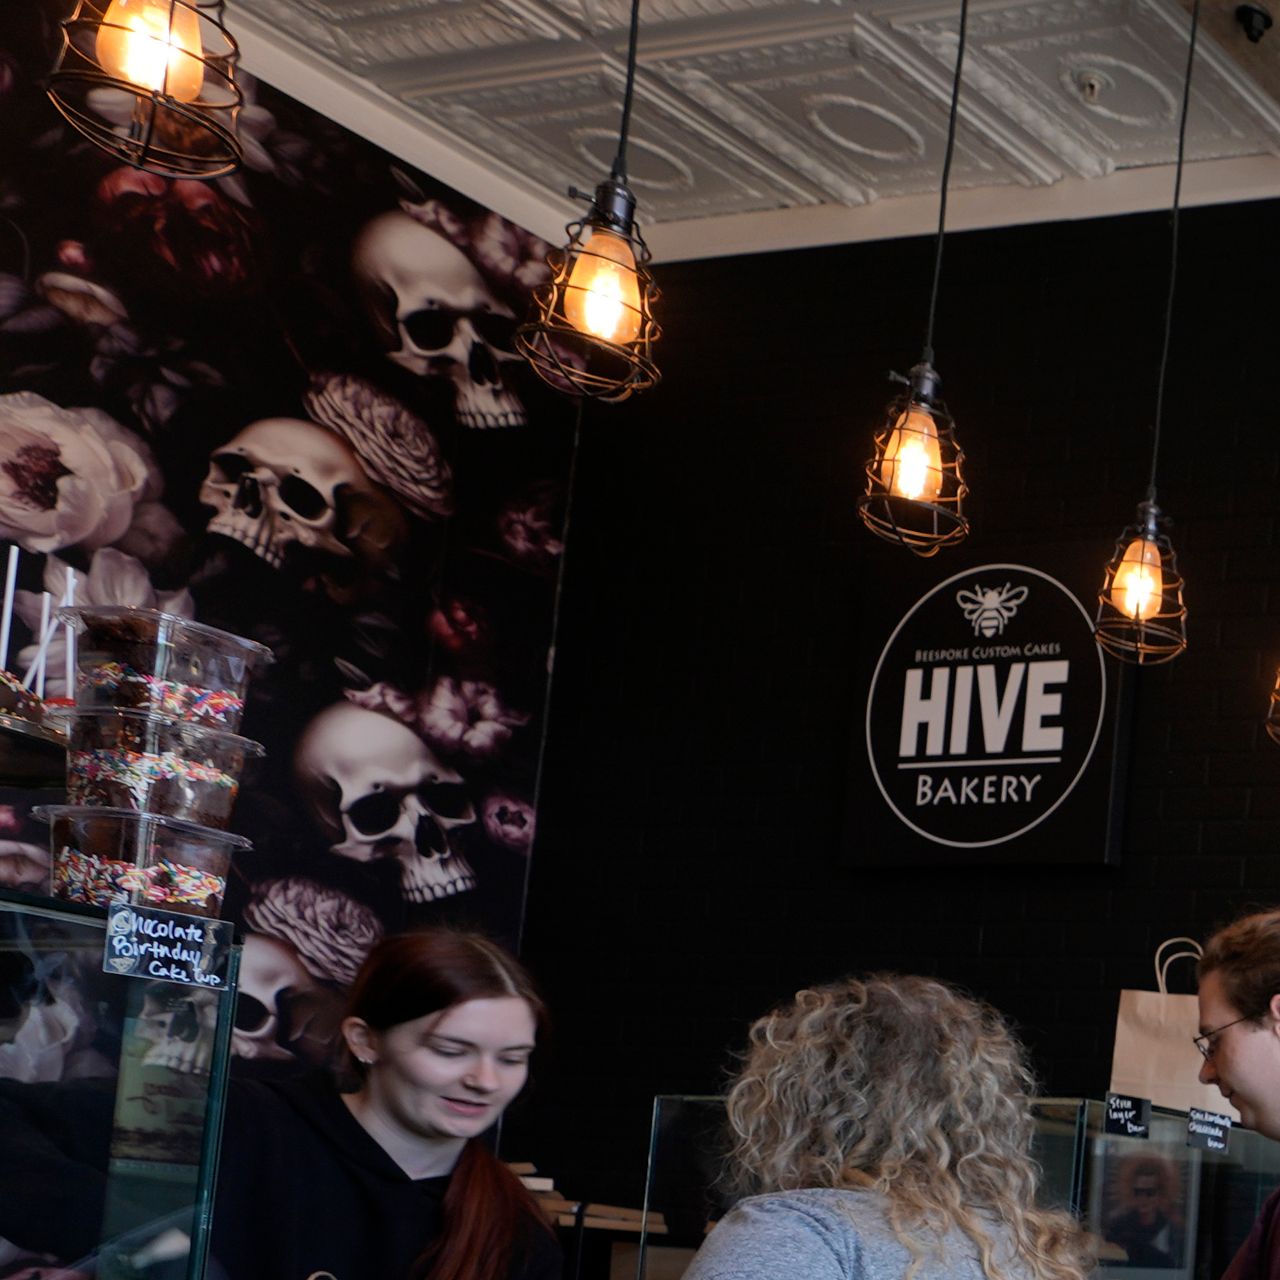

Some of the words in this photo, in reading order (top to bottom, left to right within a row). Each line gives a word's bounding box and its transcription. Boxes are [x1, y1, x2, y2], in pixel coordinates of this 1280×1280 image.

[899, 660, 1069, 757] HIVE
[916, 774, 1041, 806] BAKERY
[112, 910, 203, 943] Chocolate
[148, 961, 190, 982] Cake
